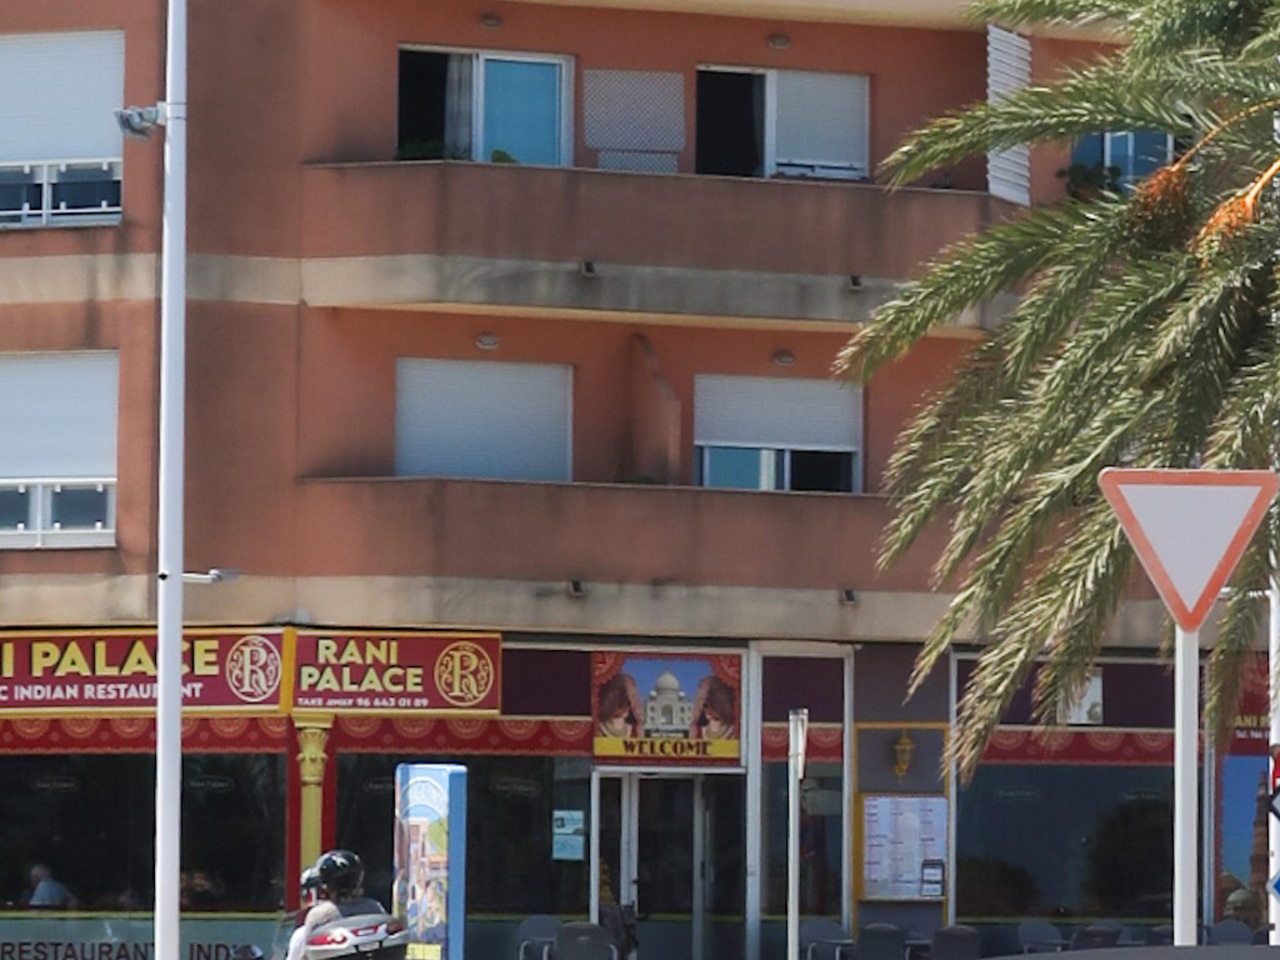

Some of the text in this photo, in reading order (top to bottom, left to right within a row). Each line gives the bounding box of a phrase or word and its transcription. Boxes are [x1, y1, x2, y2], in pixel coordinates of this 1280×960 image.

[317, 638, 399, 665] RANI
[300, 665, 424, 693] PALACE
[14, 684, 80, 700] INDIAN
[84, 682, 203, 699] RESTAUNT
[356, 697, 370, 707] 96
[622, 739, 713, 756] WELCOME
